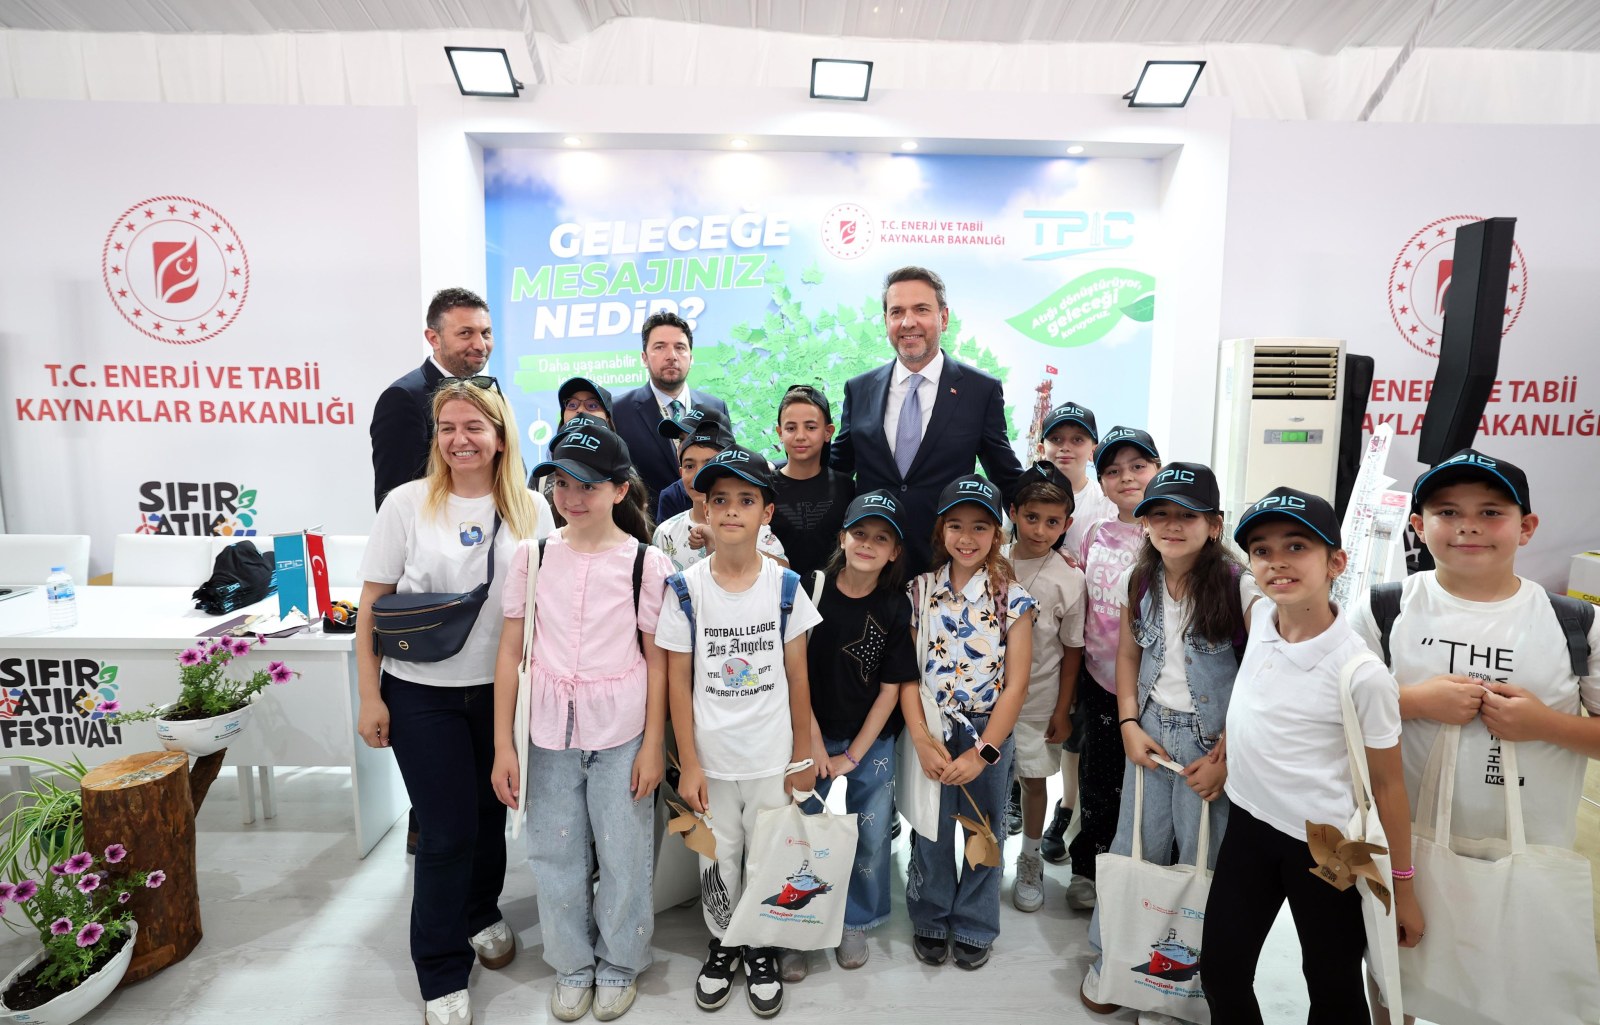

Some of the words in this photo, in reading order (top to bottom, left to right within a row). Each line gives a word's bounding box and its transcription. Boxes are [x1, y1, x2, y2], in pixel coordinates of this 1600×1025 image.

[550, 203, 790, 258] GELECEĞE
[880, 220, 899, 230] T.C.
[901, 219, 938, 231] ENERJİ
[940, 221, 953, 231] VE
[956, 220, 983, 232] TABİİ
[1023, 210, 1135, 248] TPIC
[880, 233, 945, 244] KAYNAKLAR
[948, 234, 1005, 246] BAKANLIĞI
[511, 253, 767, 301] MESAJINIZ
[1046, 288, 1119, 338] geleceği
[538, 358, 570, 373] Daha
[572, 354, 637, 374] yaşanabilir
[45, 364, 96, 388] T.C.
[104, 361, 199, 389] ENERJİ
[206, 366, 242, 388] VE
[248, 362, 321, 390] TABİİ
[1508, 376, 1578, 403] TABİİ
[15, 399, 191, 423] KAYNAKLAR
[199, 397, 355, 425] BAKANLIĞI
[1055, 406, 1084, 418] TPIC
[1475, 410, 1600, 438] AKANLIĞI
[565, 432, 600, 449] TPIC
[1103, 428, 1136, 443] TPIC
[716, 450, 750, 463] TPIC
[1156, 469, 1195, 482] TPIC
[139, 481, 239, 515] SIFIR
[959, 481, 993, 497] TPIC
[864, 495, 896, 512] TPIC
[1254, 495, 1306, 511] TPIC
[276, 559, 303, 569] TPIC
[704, 627, 745, 637] FOOTBALL
[746, 621, 776, 635] LEAGUE
[707, 641, 726, 658] Los
[728, 636, 774, 656] Angeles
[0, 658, 100, 690] SIFIR
[1468, 671, 1491, 682] PERSON
[13, 687, 91, 719] ATIK
